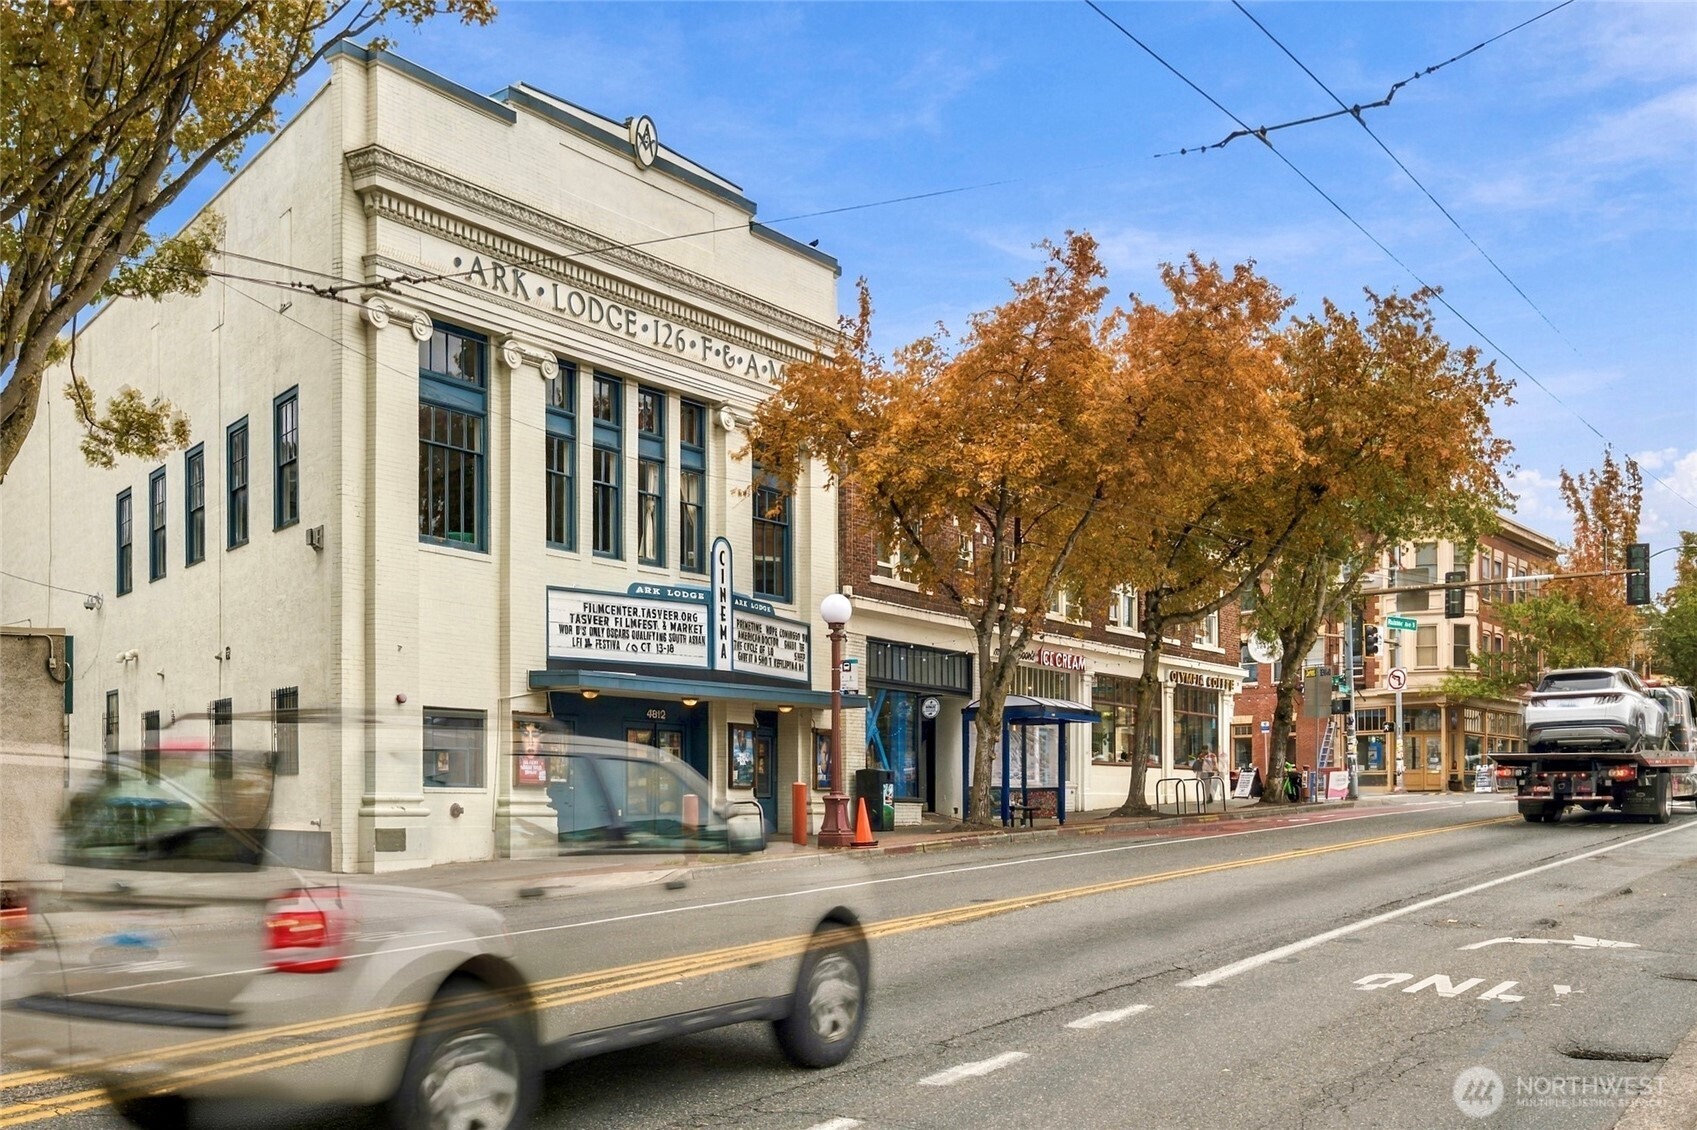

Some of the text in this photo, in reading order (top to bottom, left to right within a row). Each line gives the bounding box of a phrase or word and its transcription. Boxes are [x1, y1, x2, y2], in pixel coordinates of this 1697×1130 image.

[465, 255, 531, 300] ARK
[552, 283, 638, 337] LODGE
[653, 319, 686, 353] 126
[635, 585, 705, 600] ARK LODGE
[719, 550, 728, 659] CINEMA
[735, 599, 772, 613] ARK LODGE
[569, 613, 610, 627] TASVEER
[670, 621, 704, 635] MARKET
[589, 626, 605, 638] ONLY
[606, 627, 630, 640] OSCARS
[631, 630, 667, 643] QUALIFYING
[668, 632, 688, 645] SOUTH
[688, 635, 706, 647] ASIAN
[1041, 650, 1087, 672] ICE CREAM
[646, 709, 666, 720] 4812
